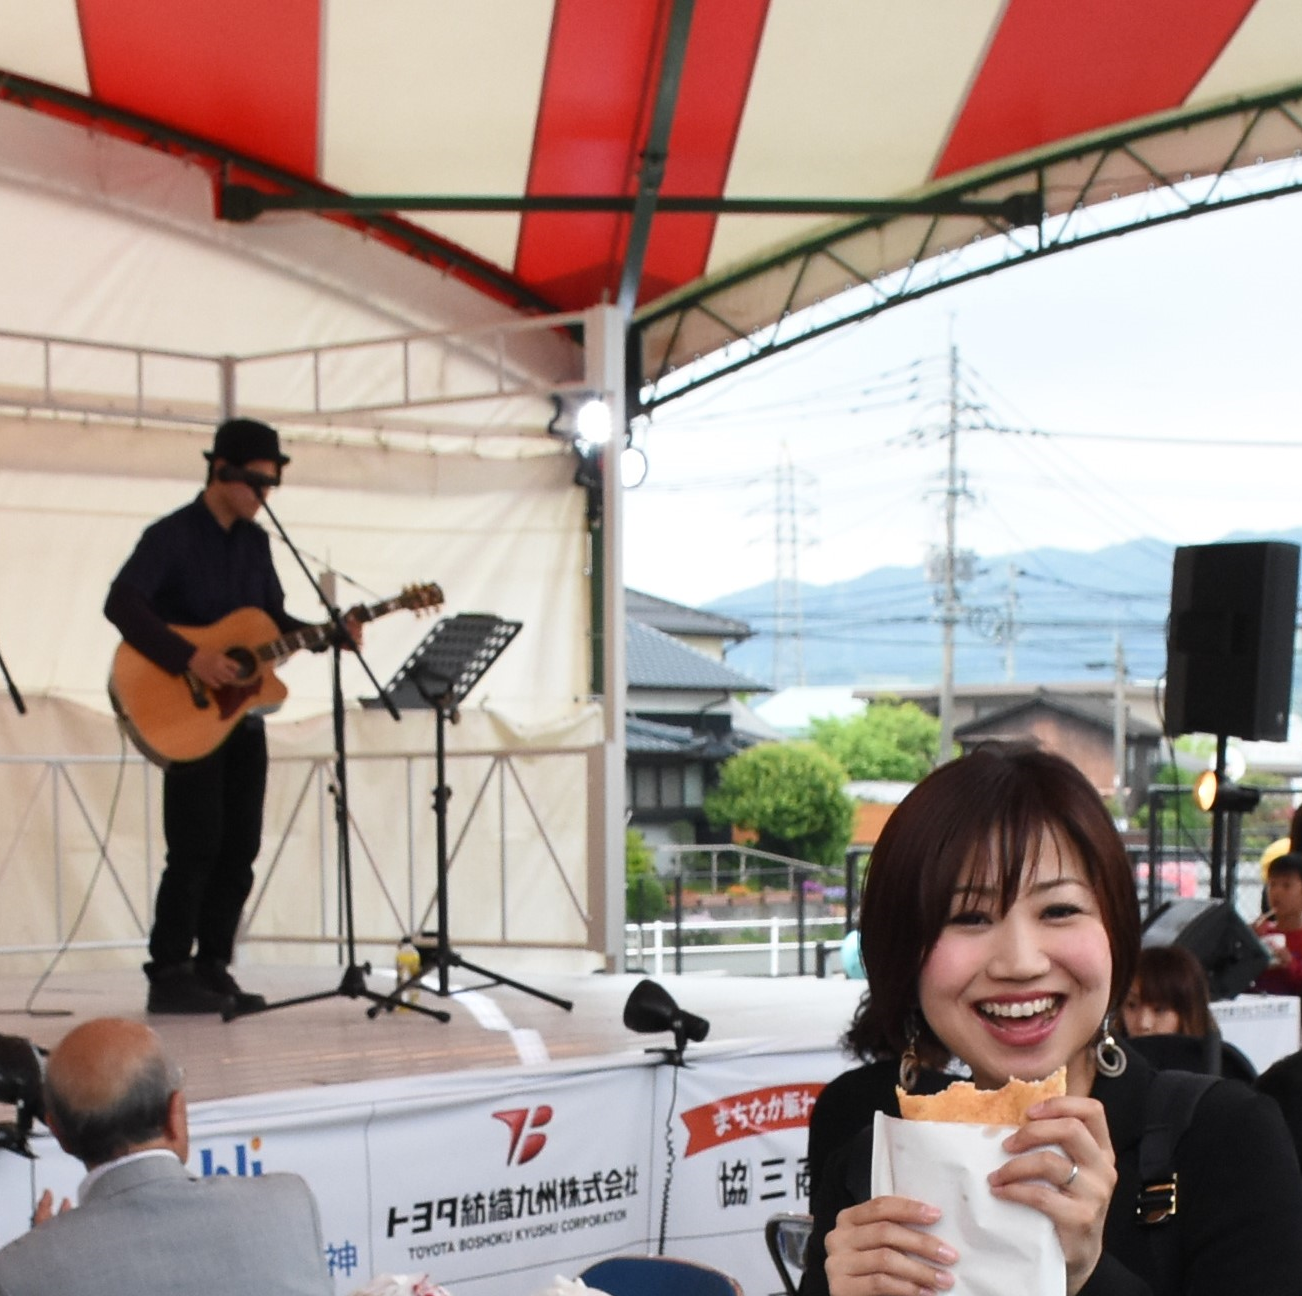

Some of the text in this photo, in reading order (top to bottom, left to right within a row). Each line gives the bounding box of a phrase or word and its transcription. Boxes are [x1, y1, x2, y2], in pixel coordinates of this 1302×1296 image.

[386, 1164, 639, 1238] トヨタ紡織九州株式会社
[409, 1209, 627, 1260] TOYOTA BOSHOKU KYUSHU CORPORATION
